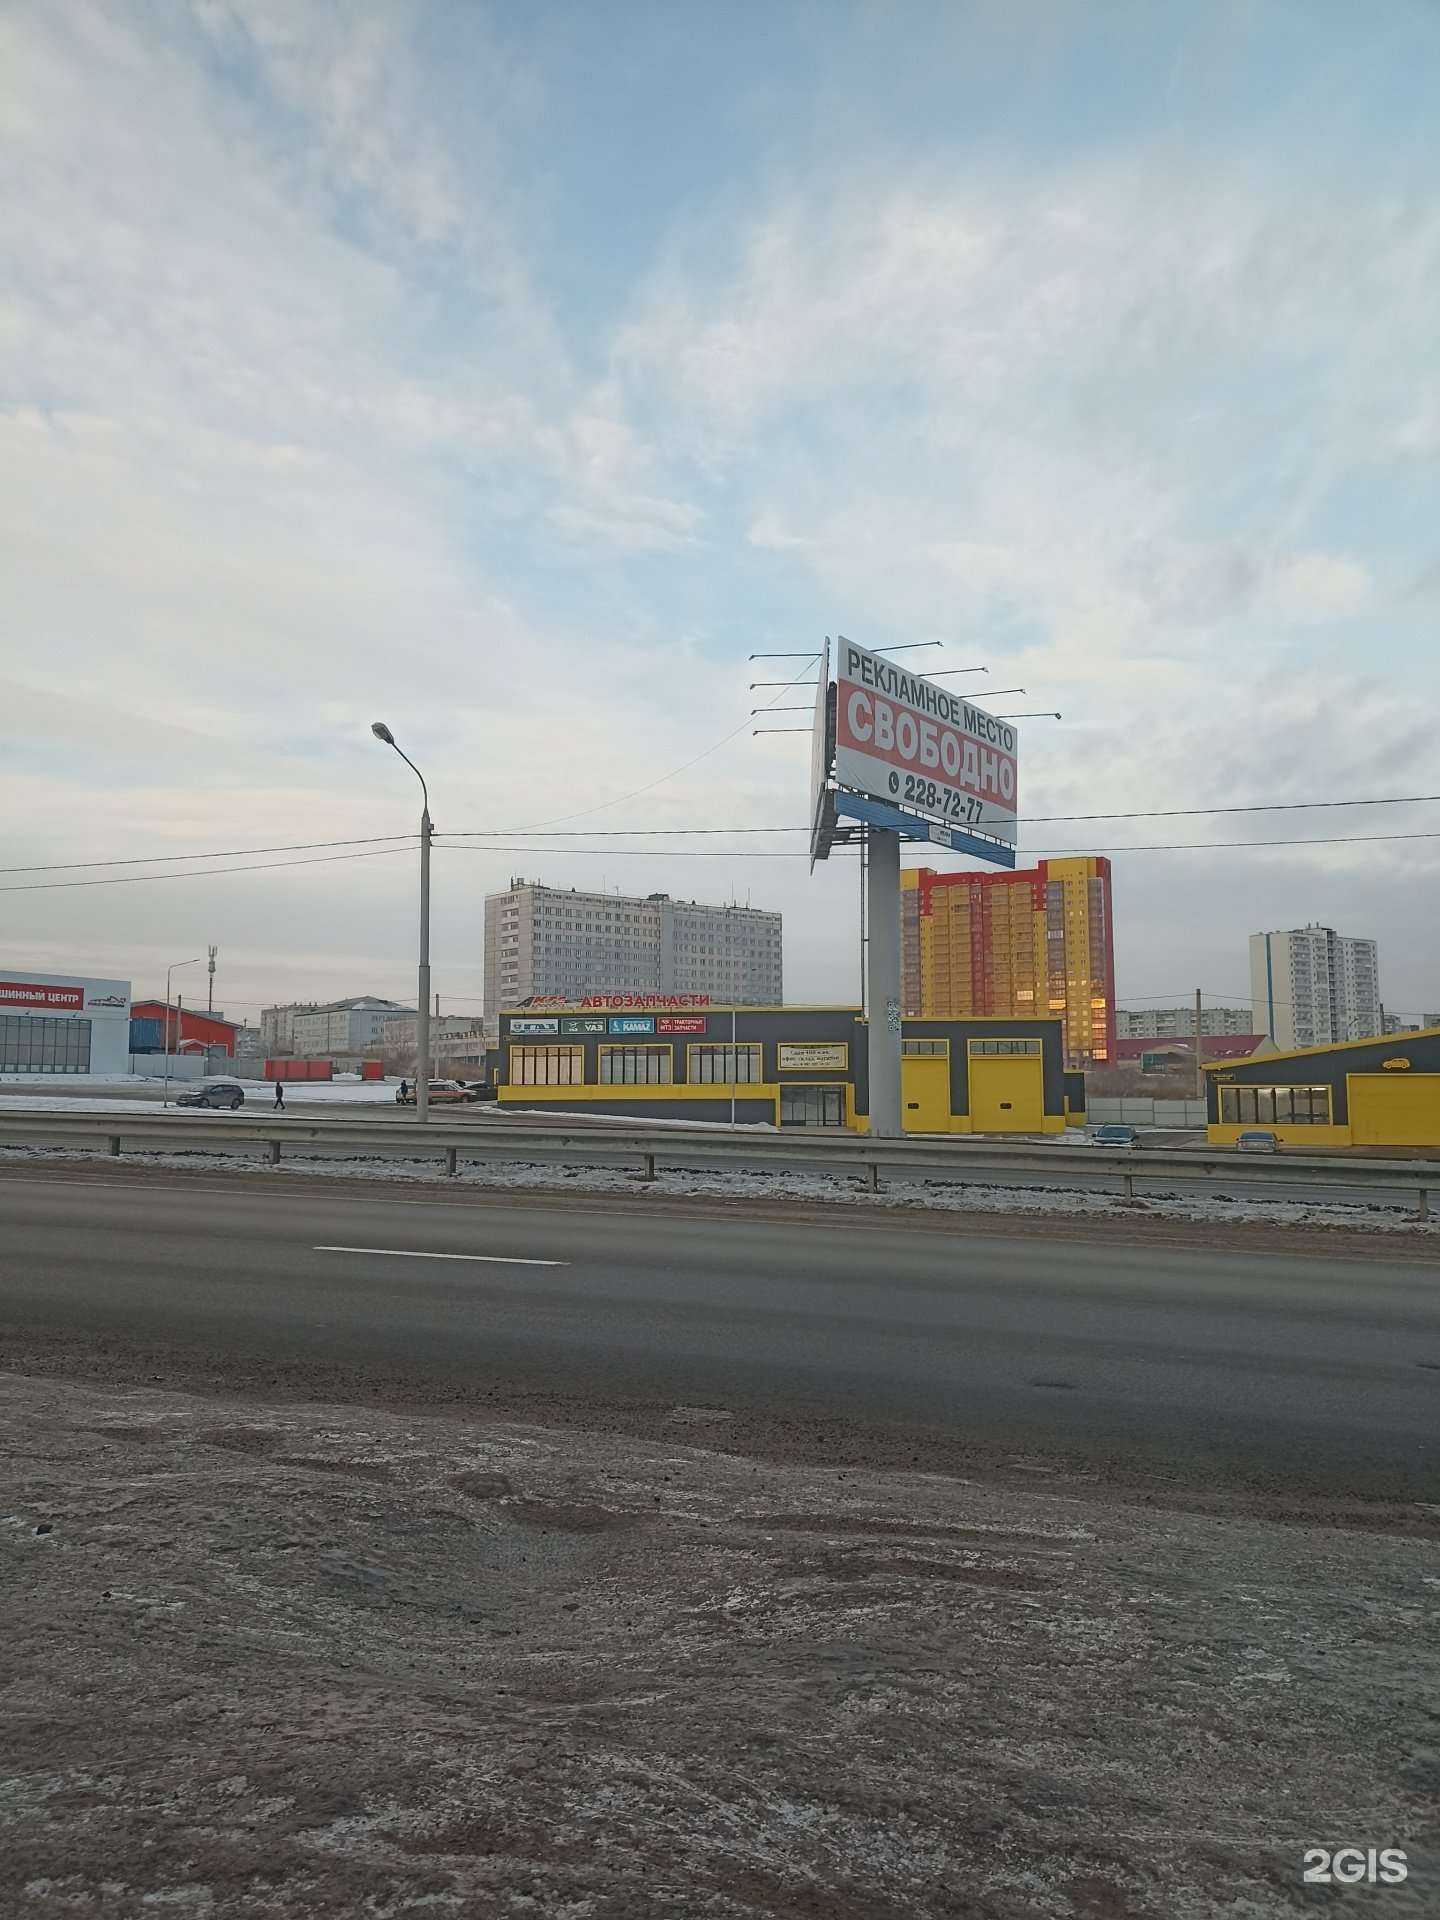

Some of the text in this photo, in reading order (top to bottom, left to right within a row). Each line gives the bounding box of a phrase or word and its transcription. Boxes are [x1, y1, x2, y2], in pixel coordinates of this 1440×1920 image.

[847, 648, 1014, 752] РЕКЛАМНОЕ МЕСТО
[847, 690, 1015, 801] СВОБОДНО
[904, 774, 984, 824] 228-72-77
[47, 993, 79, 1003] ЦЕНТР
[581, 994, 710, 1009] АВТОЗАПЧАСТИ
[585, 1024, 604, 1032] УАЗ
[622, 1023, 651, 1031] KAMAZ
